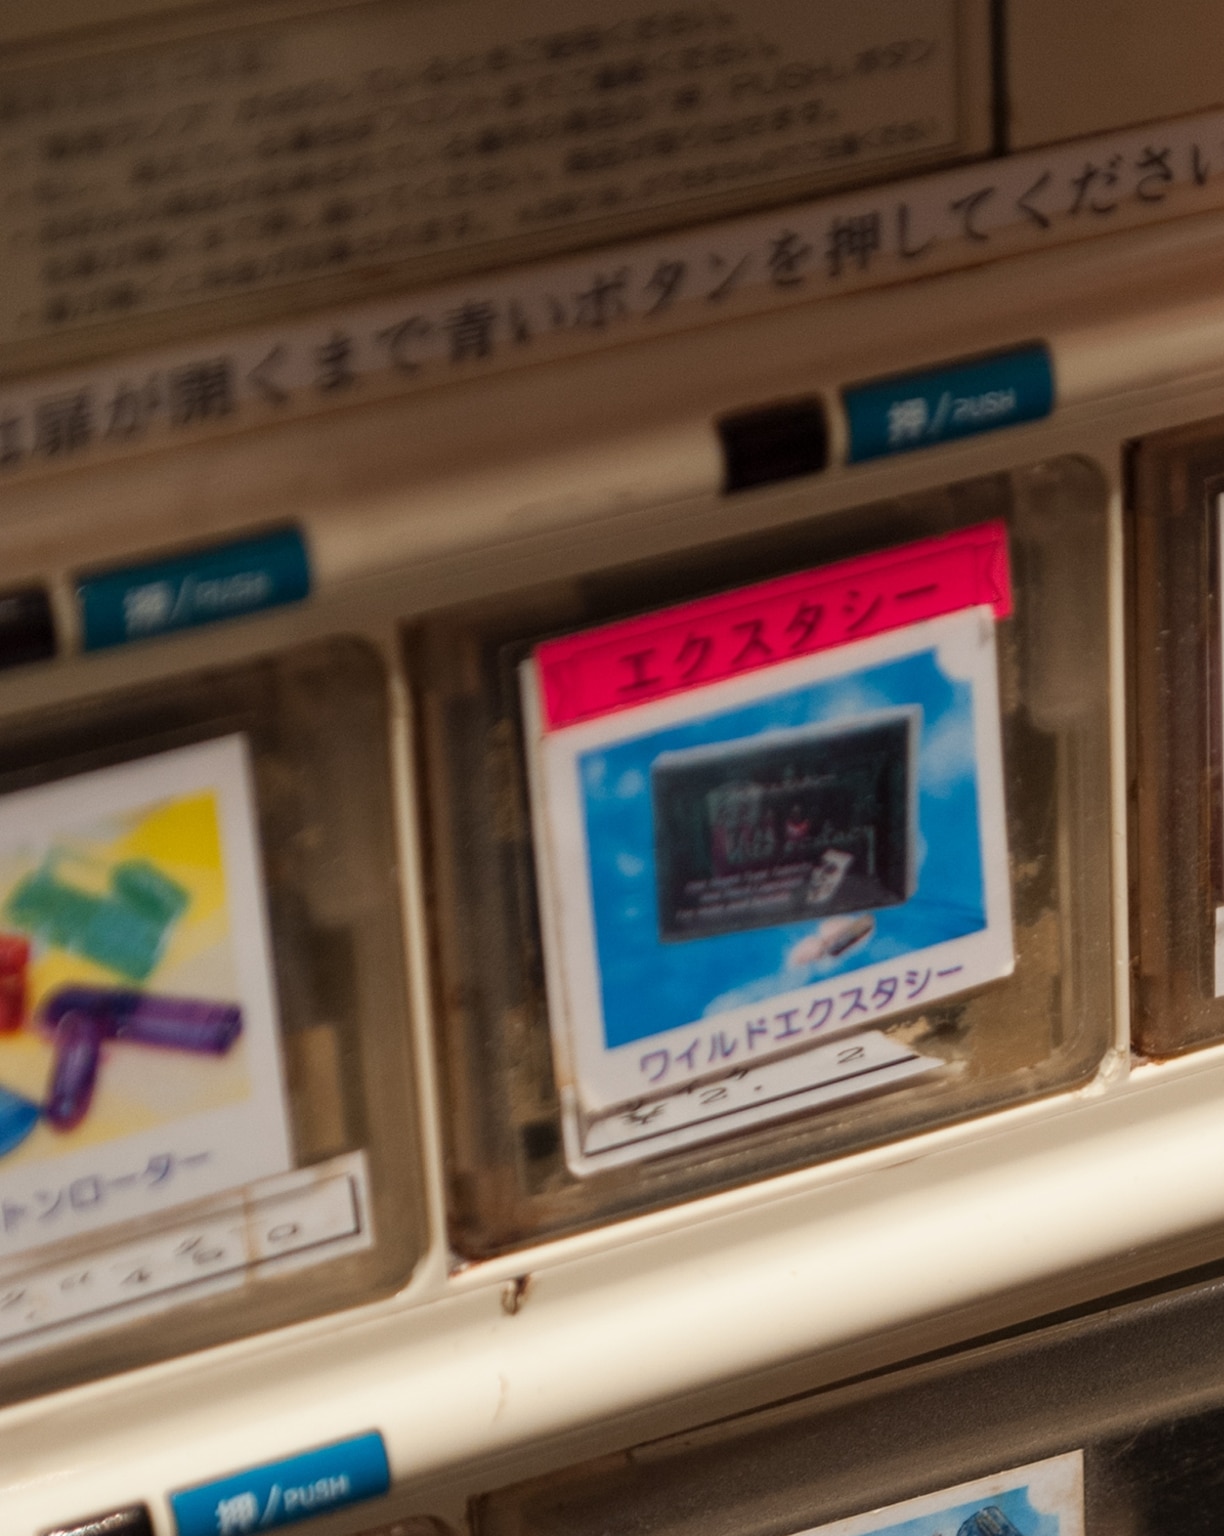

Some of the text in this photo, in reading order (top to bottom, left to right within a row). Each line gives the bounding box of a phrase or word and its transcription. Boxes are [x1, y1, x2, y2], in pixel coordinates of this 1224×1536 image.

[617, 582, 939, 692] エクスタシー
[640, 963, 965, 1083] ワイルドエクスタシー
